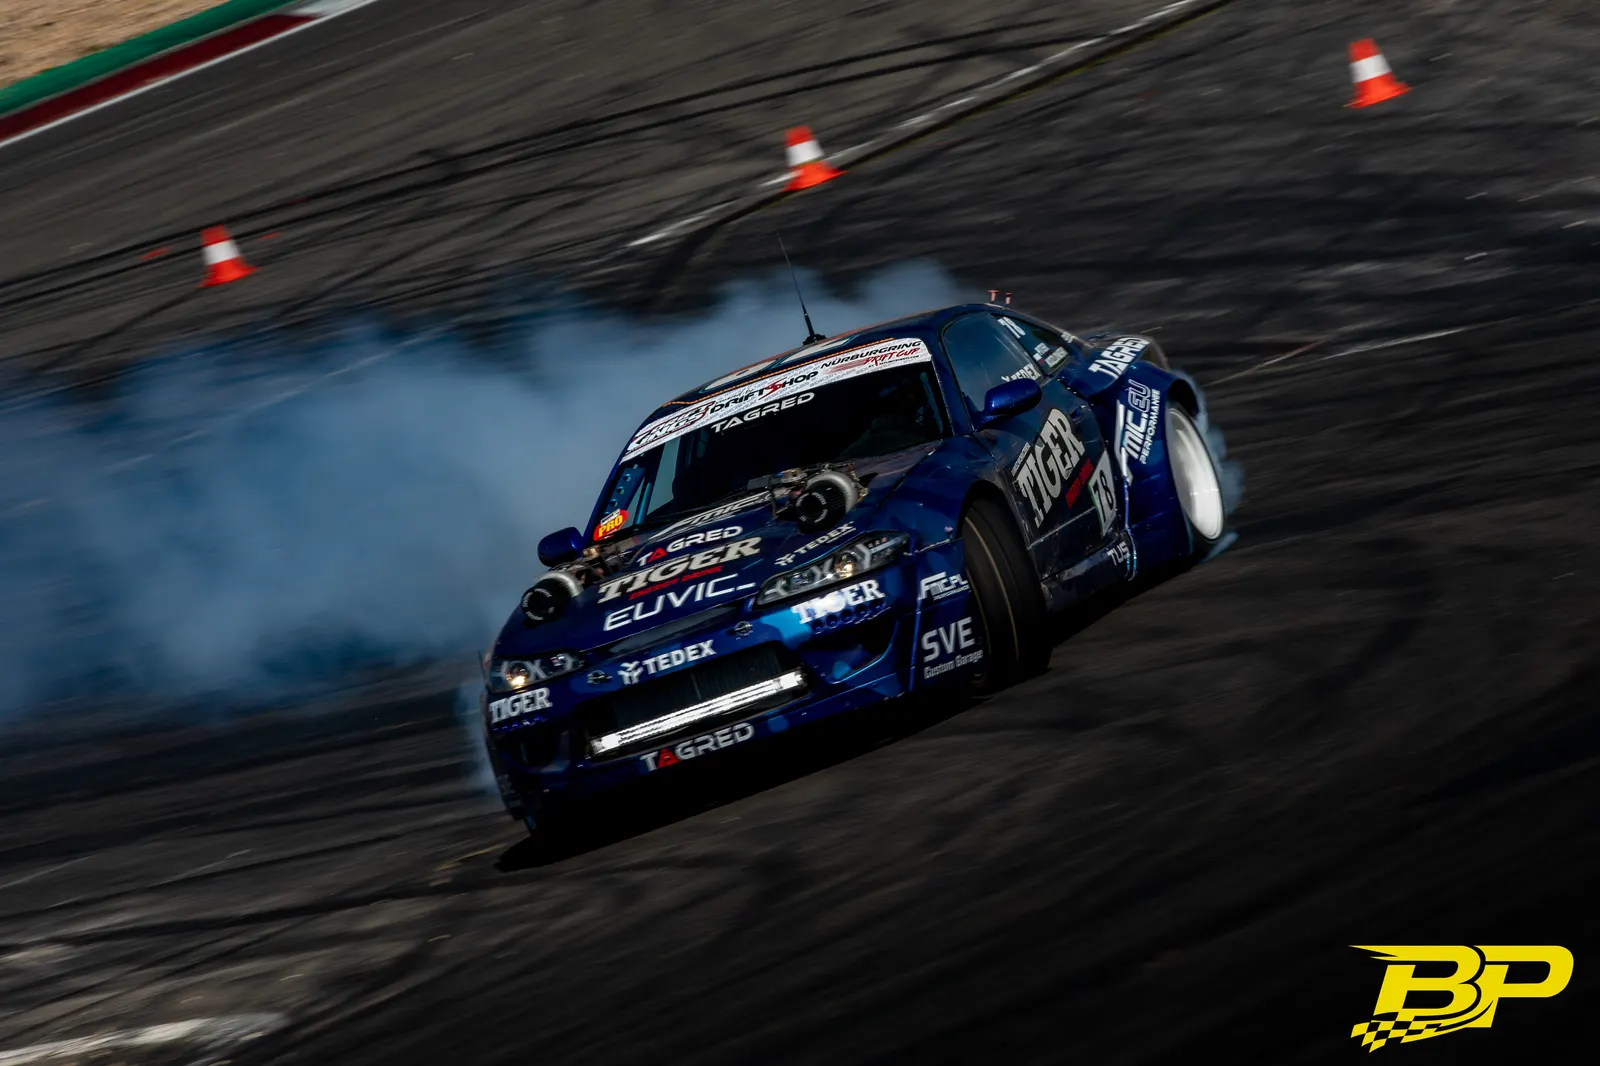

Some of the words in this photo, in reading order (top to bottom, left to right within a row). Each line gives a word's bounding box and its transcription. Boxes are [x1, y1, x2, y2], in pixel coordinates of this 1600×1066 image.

[1088, 337, 1150, 380] TAGRE
[711, 391, 816, 434] TAGRED
[1015, 407, 1086, 529] TIGER
[598, 514, 623, 537] PRO
[636, 525, 744, 567] TAGRED
[793, 520, 855, 555] TEDEX
[597, 536, 763, 605] TIGER
[791, 579, 887, 625] TIGER
[642, 639, 717, 676] TEDEX
[921, 616, 976, 664] SVE
[923, 660, 956, 680] Custom
[955, 649, 984, 668] Garage
[489, 687, 553, 724] TIGER
[640, 722, 755, 773] TAGRED
